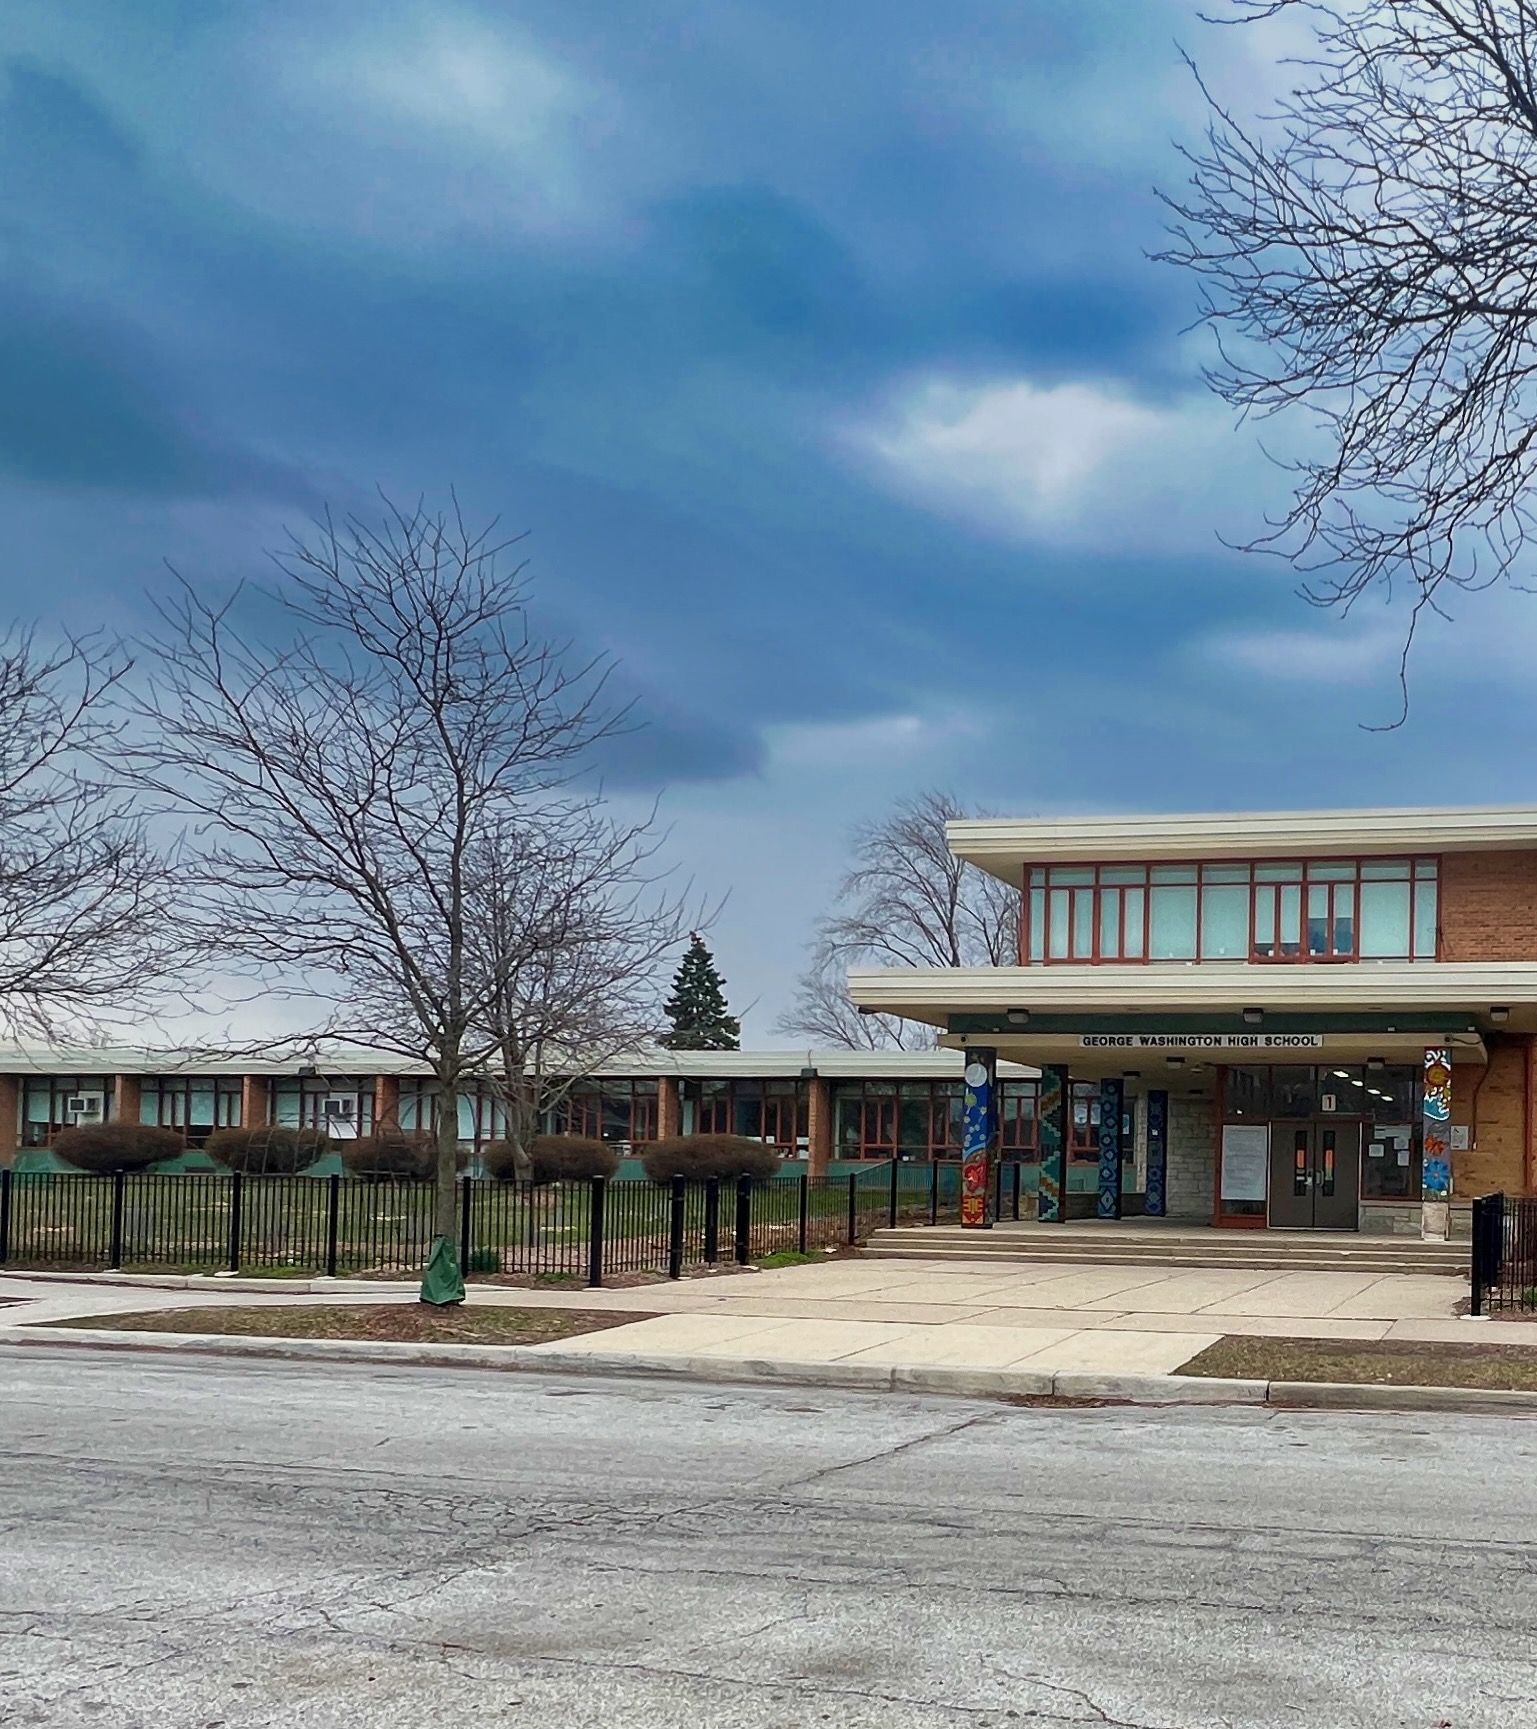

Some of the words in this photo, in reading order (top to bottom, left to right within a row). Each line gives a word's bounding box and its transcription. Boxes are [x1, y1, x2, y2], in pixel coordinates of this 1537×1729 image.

[1083, 1036, 1133, 1046] GEORGE
[1139, 1036, 1222, 1046] WASHINGTON
[1228, 1036, 1258, 1046] HIGH
[1264, 1036, 1318, 1046] SCHOOL
[1326, 1097, 1333, 1109] 1
